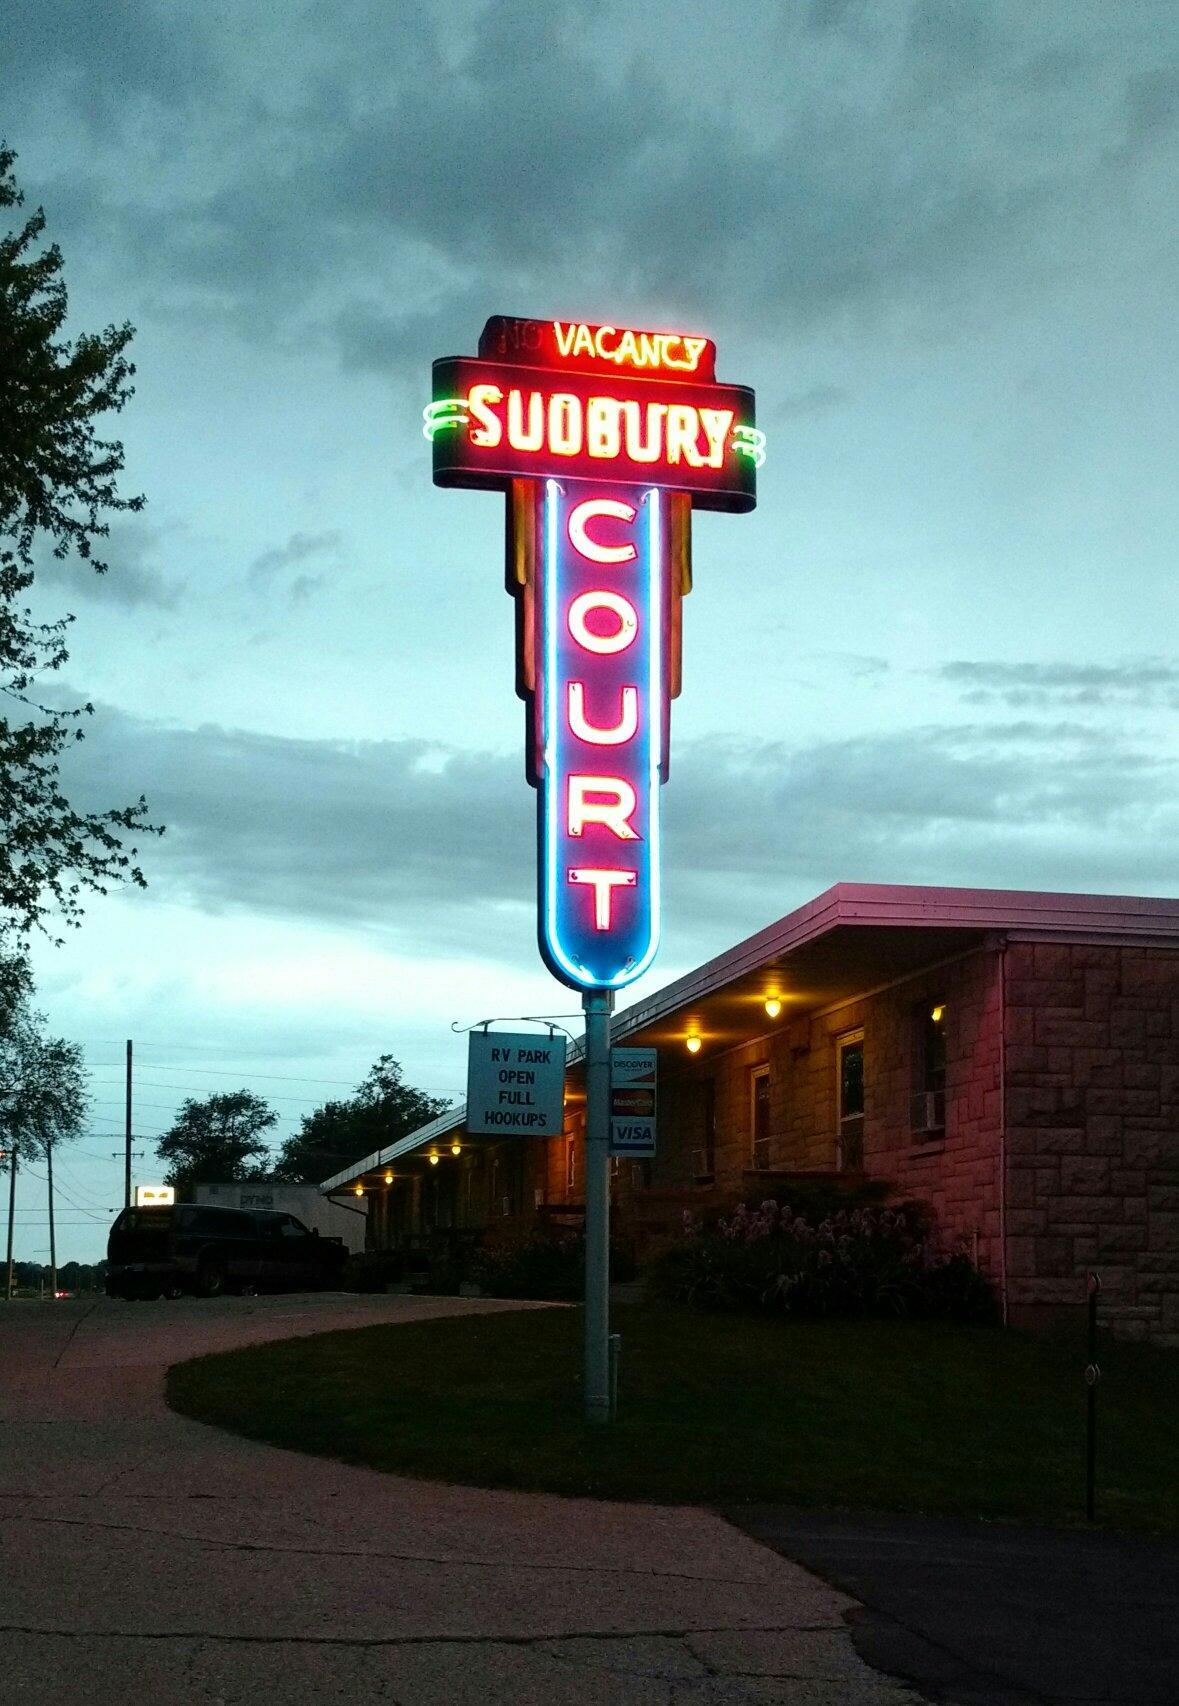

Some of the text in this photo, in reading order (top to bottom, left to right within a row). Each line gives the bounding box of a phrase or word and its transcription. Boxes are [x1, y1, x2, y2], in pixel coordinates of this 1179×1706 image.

[553, 321, 708, 371] VACANCY
[468, 384, 734, 468] SUDBURY
[567, 498, 643, 931] COURT
[491, 1048, 551, 1064] RV PARK
[613, 1060, 653, 1068] DISCOVER
[498, 1070, 535, 1084] OPEN
[498, 1091, 535, 1105] FULL
[484, 1111, 547, 1127] HOOKUPS
[617, 1126, 652, 1139] VISA
